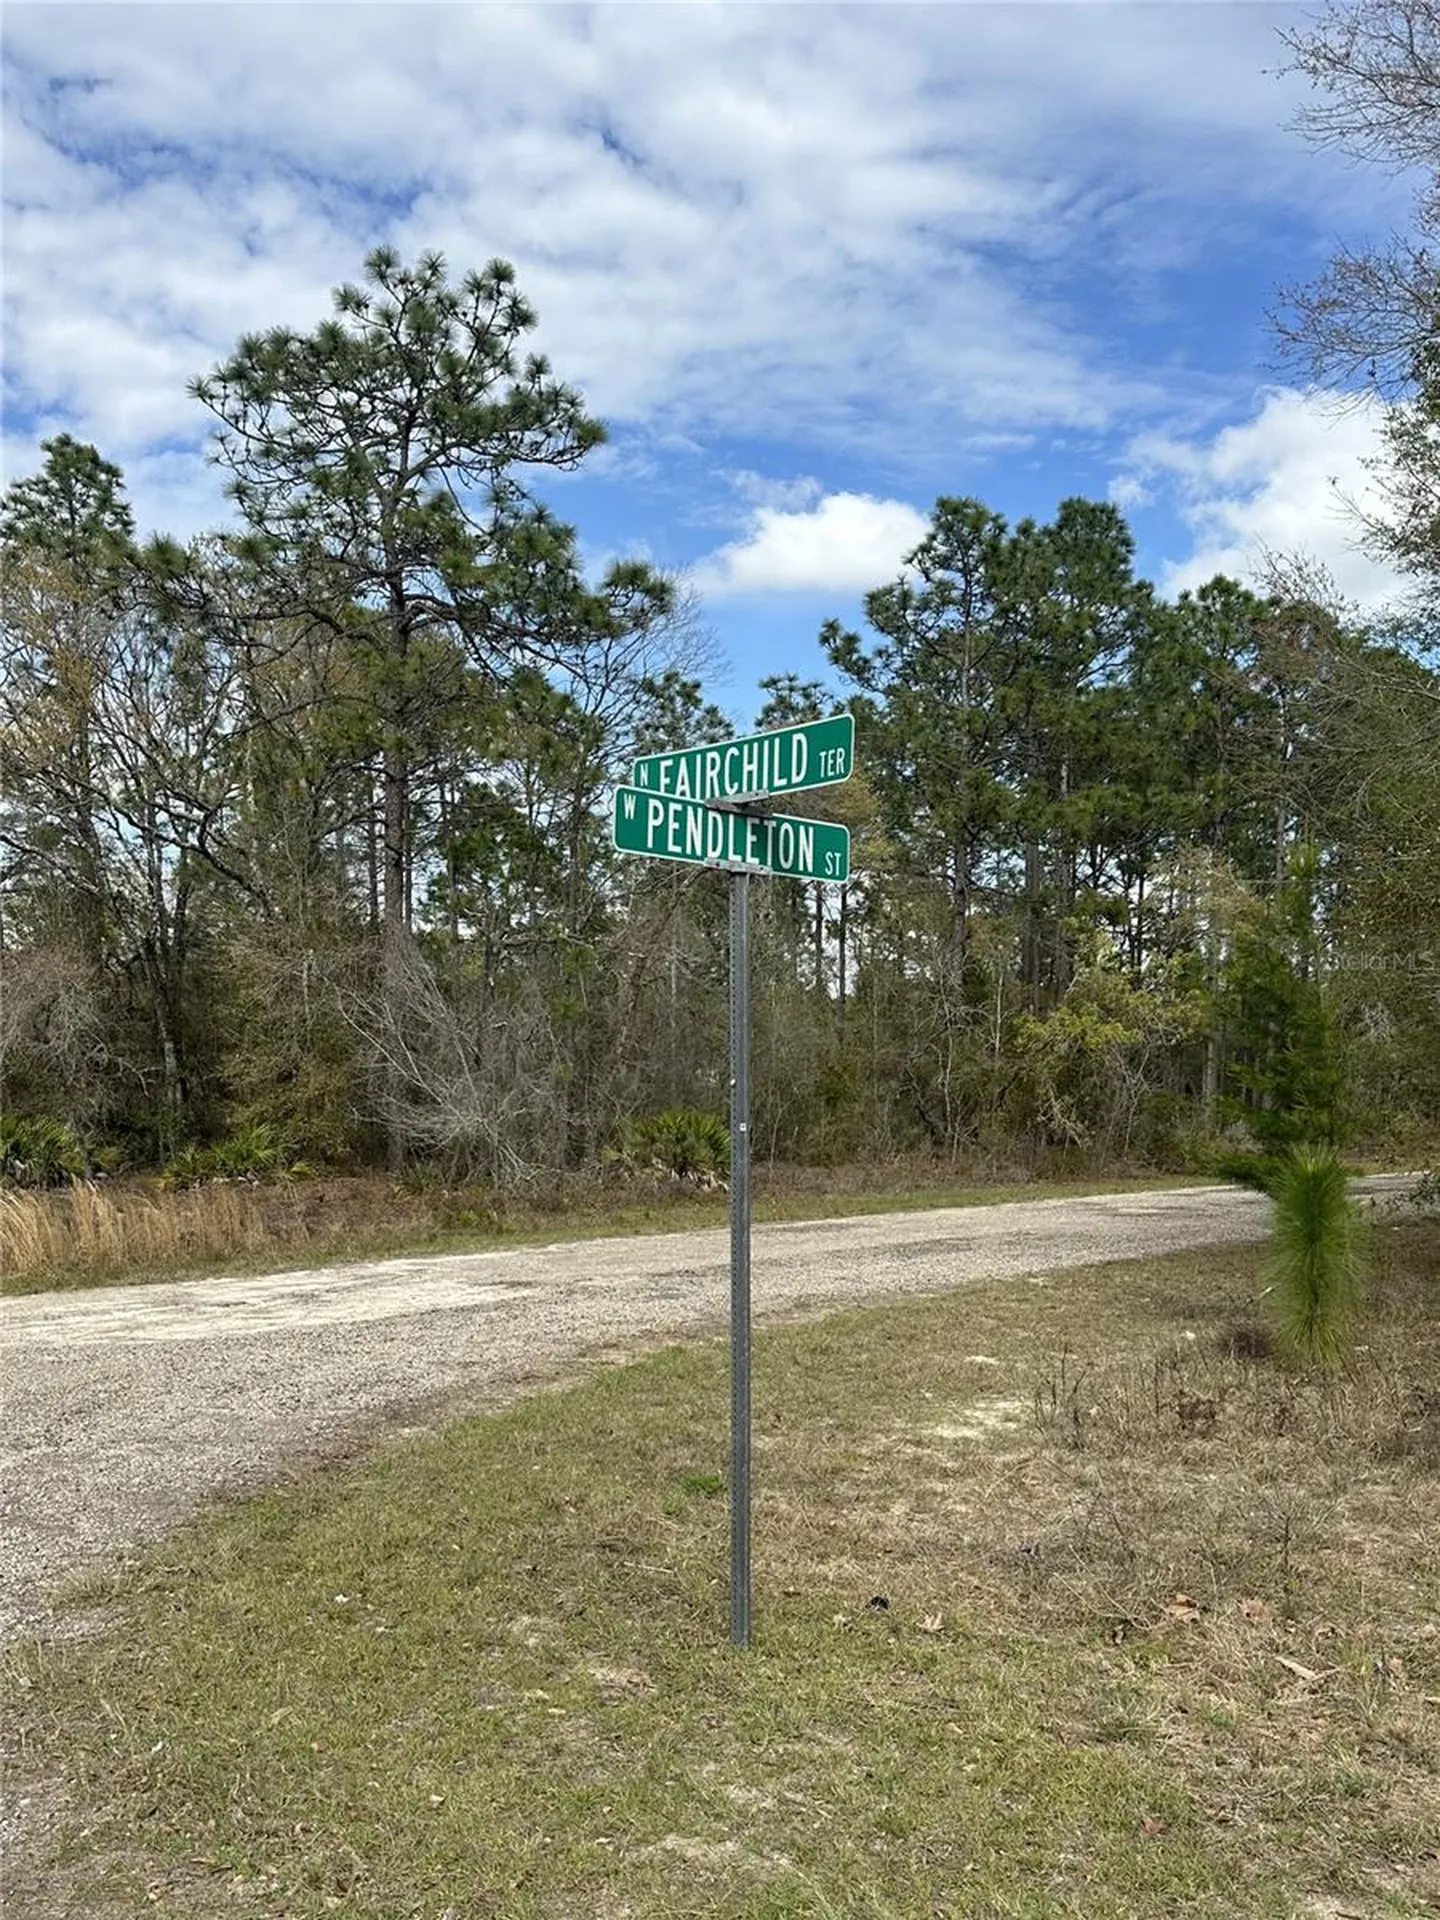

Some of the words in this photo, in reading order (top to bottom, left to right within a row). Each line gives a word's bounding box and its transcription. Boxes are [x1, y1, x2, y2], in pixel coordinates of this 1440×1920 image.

[640, 762, 648, 786] N
[659, 732, 808, 800] FAIRCHILD
[819, 747, 845, 778] TER
[623, 793, 637, 820] W
[647, 799, 814, 873] PENDLETON
[824, 851, 841, 876] ST
